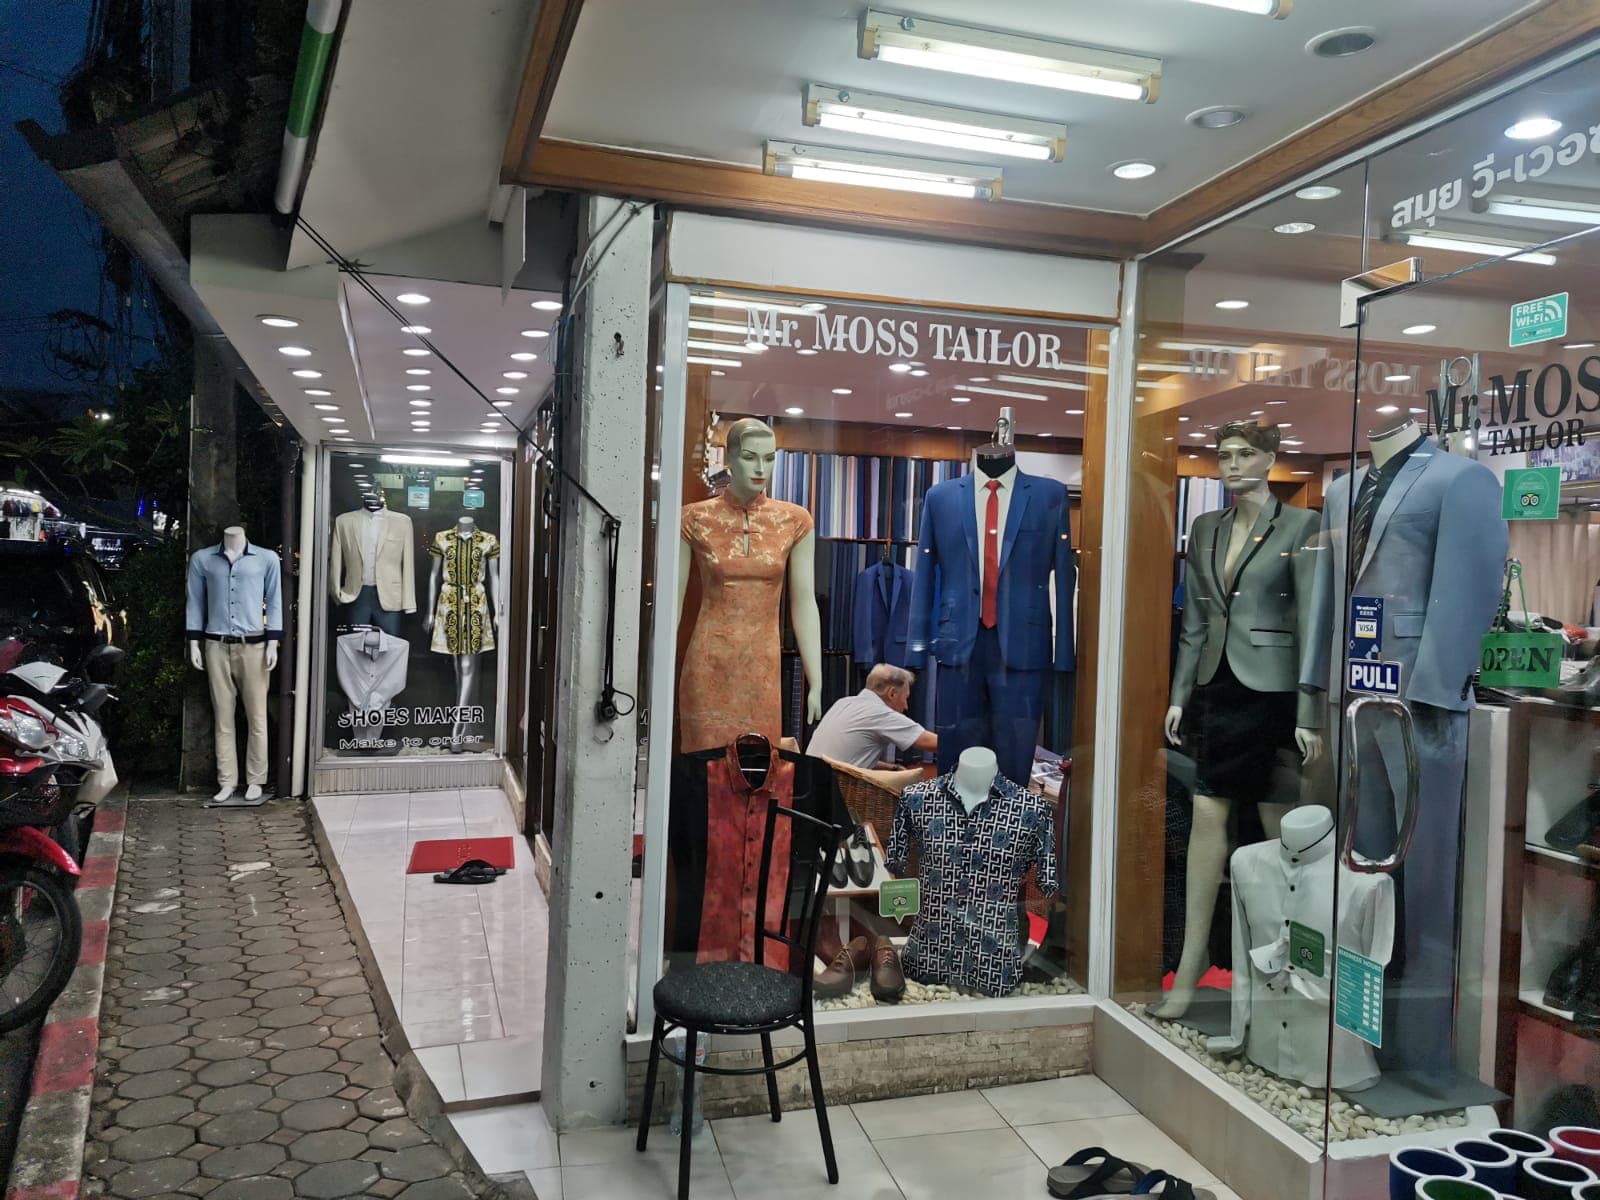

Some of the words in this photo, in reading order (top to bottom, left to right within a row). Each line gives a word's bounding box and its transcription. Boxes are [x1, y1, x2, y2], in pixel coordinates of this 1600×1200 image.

[1516, 302, 1544, 317] FREE
[743, 306, 802, 349] Mr.
[812, 313, 918, 358] MOSS
[928, 323, 1063, 370] TAILOR
[1425, 385, 1482, 436] Mr.
[1487, 418, 1586, 457] TAILOR
[1359, 623, 1375, 633] VISA
[1482, 647, 1555, 673] OPEN
[1351, 664, 1397, 690] PULL
[337, 707, 410, 728] SHOES
[414, 705, 485, 725] MAKER
[339, 738, 397, 750] Make
[401, 736, 424, 747] to
[428, 734, 485, 746] order
